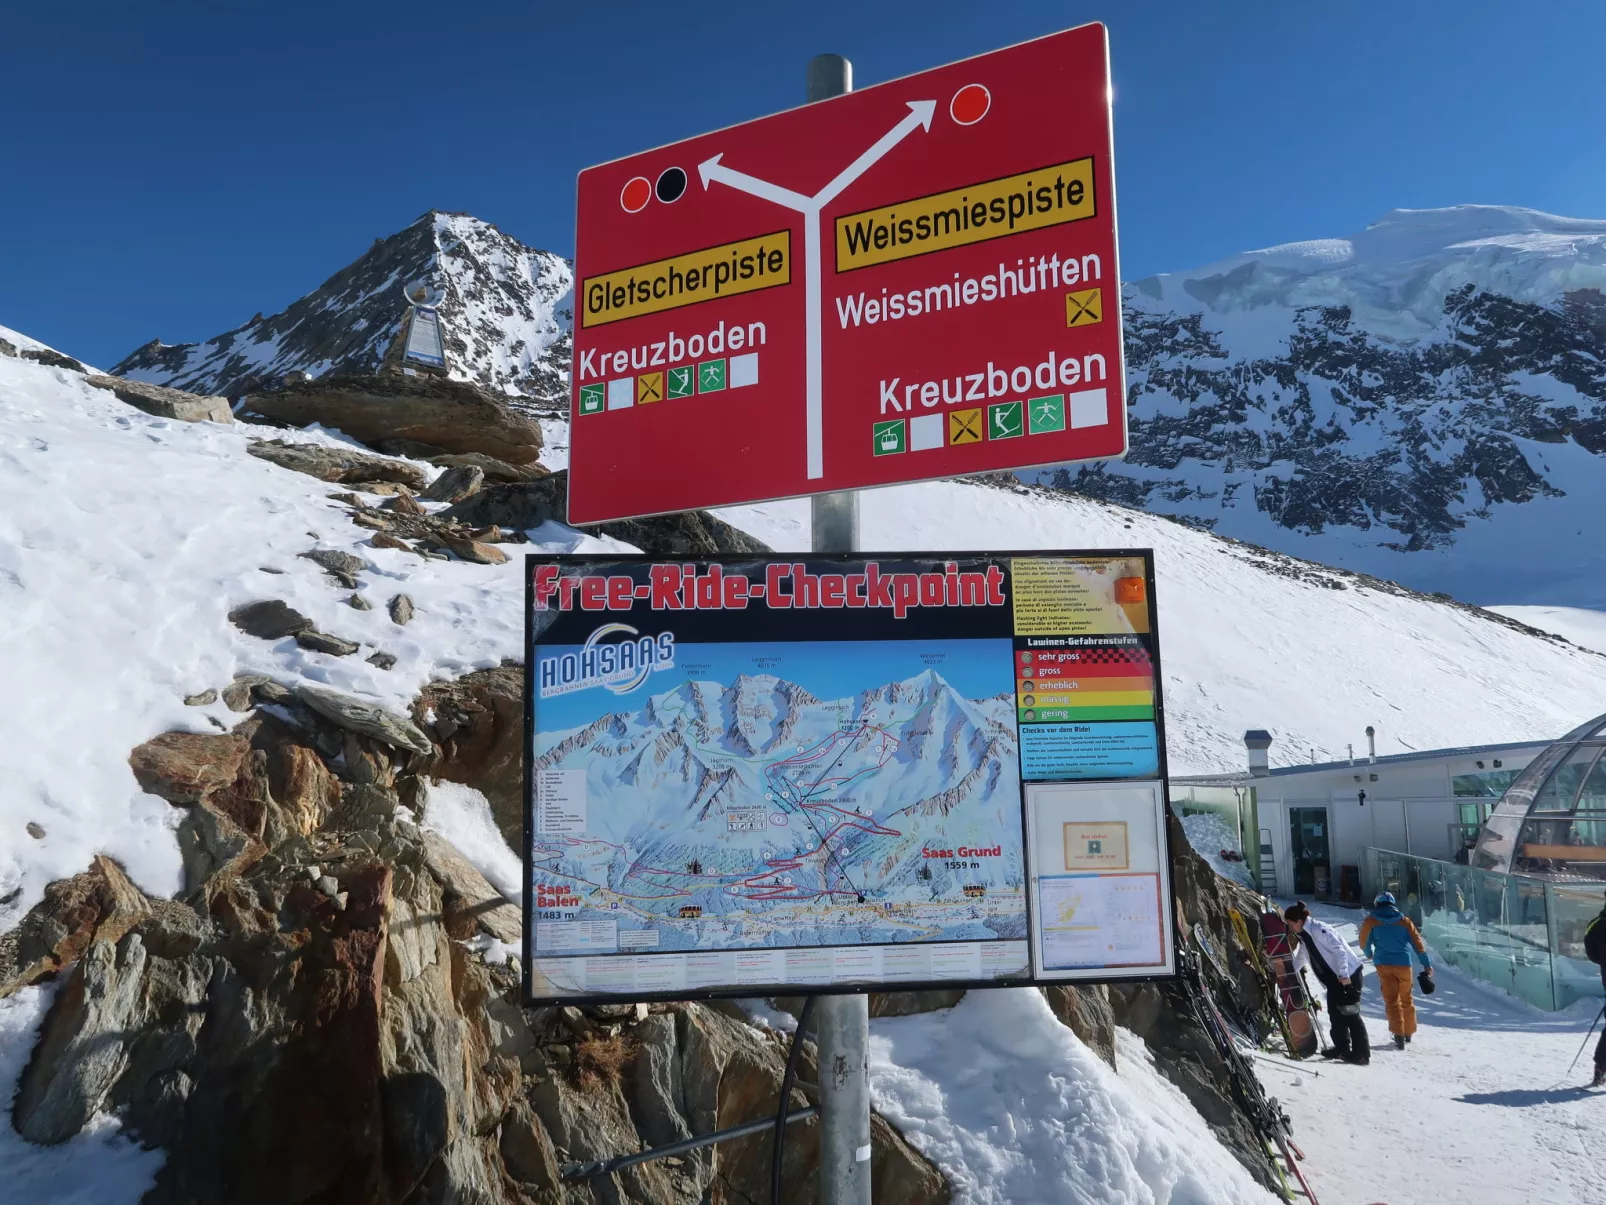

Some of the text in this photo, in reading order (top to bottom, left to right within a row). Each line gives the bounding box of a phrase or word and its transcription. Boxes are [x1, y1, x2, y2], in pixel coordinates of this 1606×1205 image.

[845, 174, 1084, 256] Weissmiespiste
[588, 246, 784, 314] Gletscherpiste
[836, 252, 1101, 329] Weissmieshütten
[580, 321, 766, 380] Kreuzboden
[880, 351, 1106, 414] Kreuzboden
[533, 562, 1006, 619] Free-Ride-Checkpoint
[1028, 636, 1138, 646] Lawinen-Gefahrenstufen
[542, 633, 673, 689] HOHSAAS
[1058, 652, 1080, 662] gross
[1039, 668, 1060, 676] gross
[542, 682, 588, 697] BERGBAHNEN
[1042, 710, 1068, 719] gering
[922, 845, 1001, 858] Saas Grund
[537, 884, 571, 895] Saas
[537, 895, 579, 907] Balen
